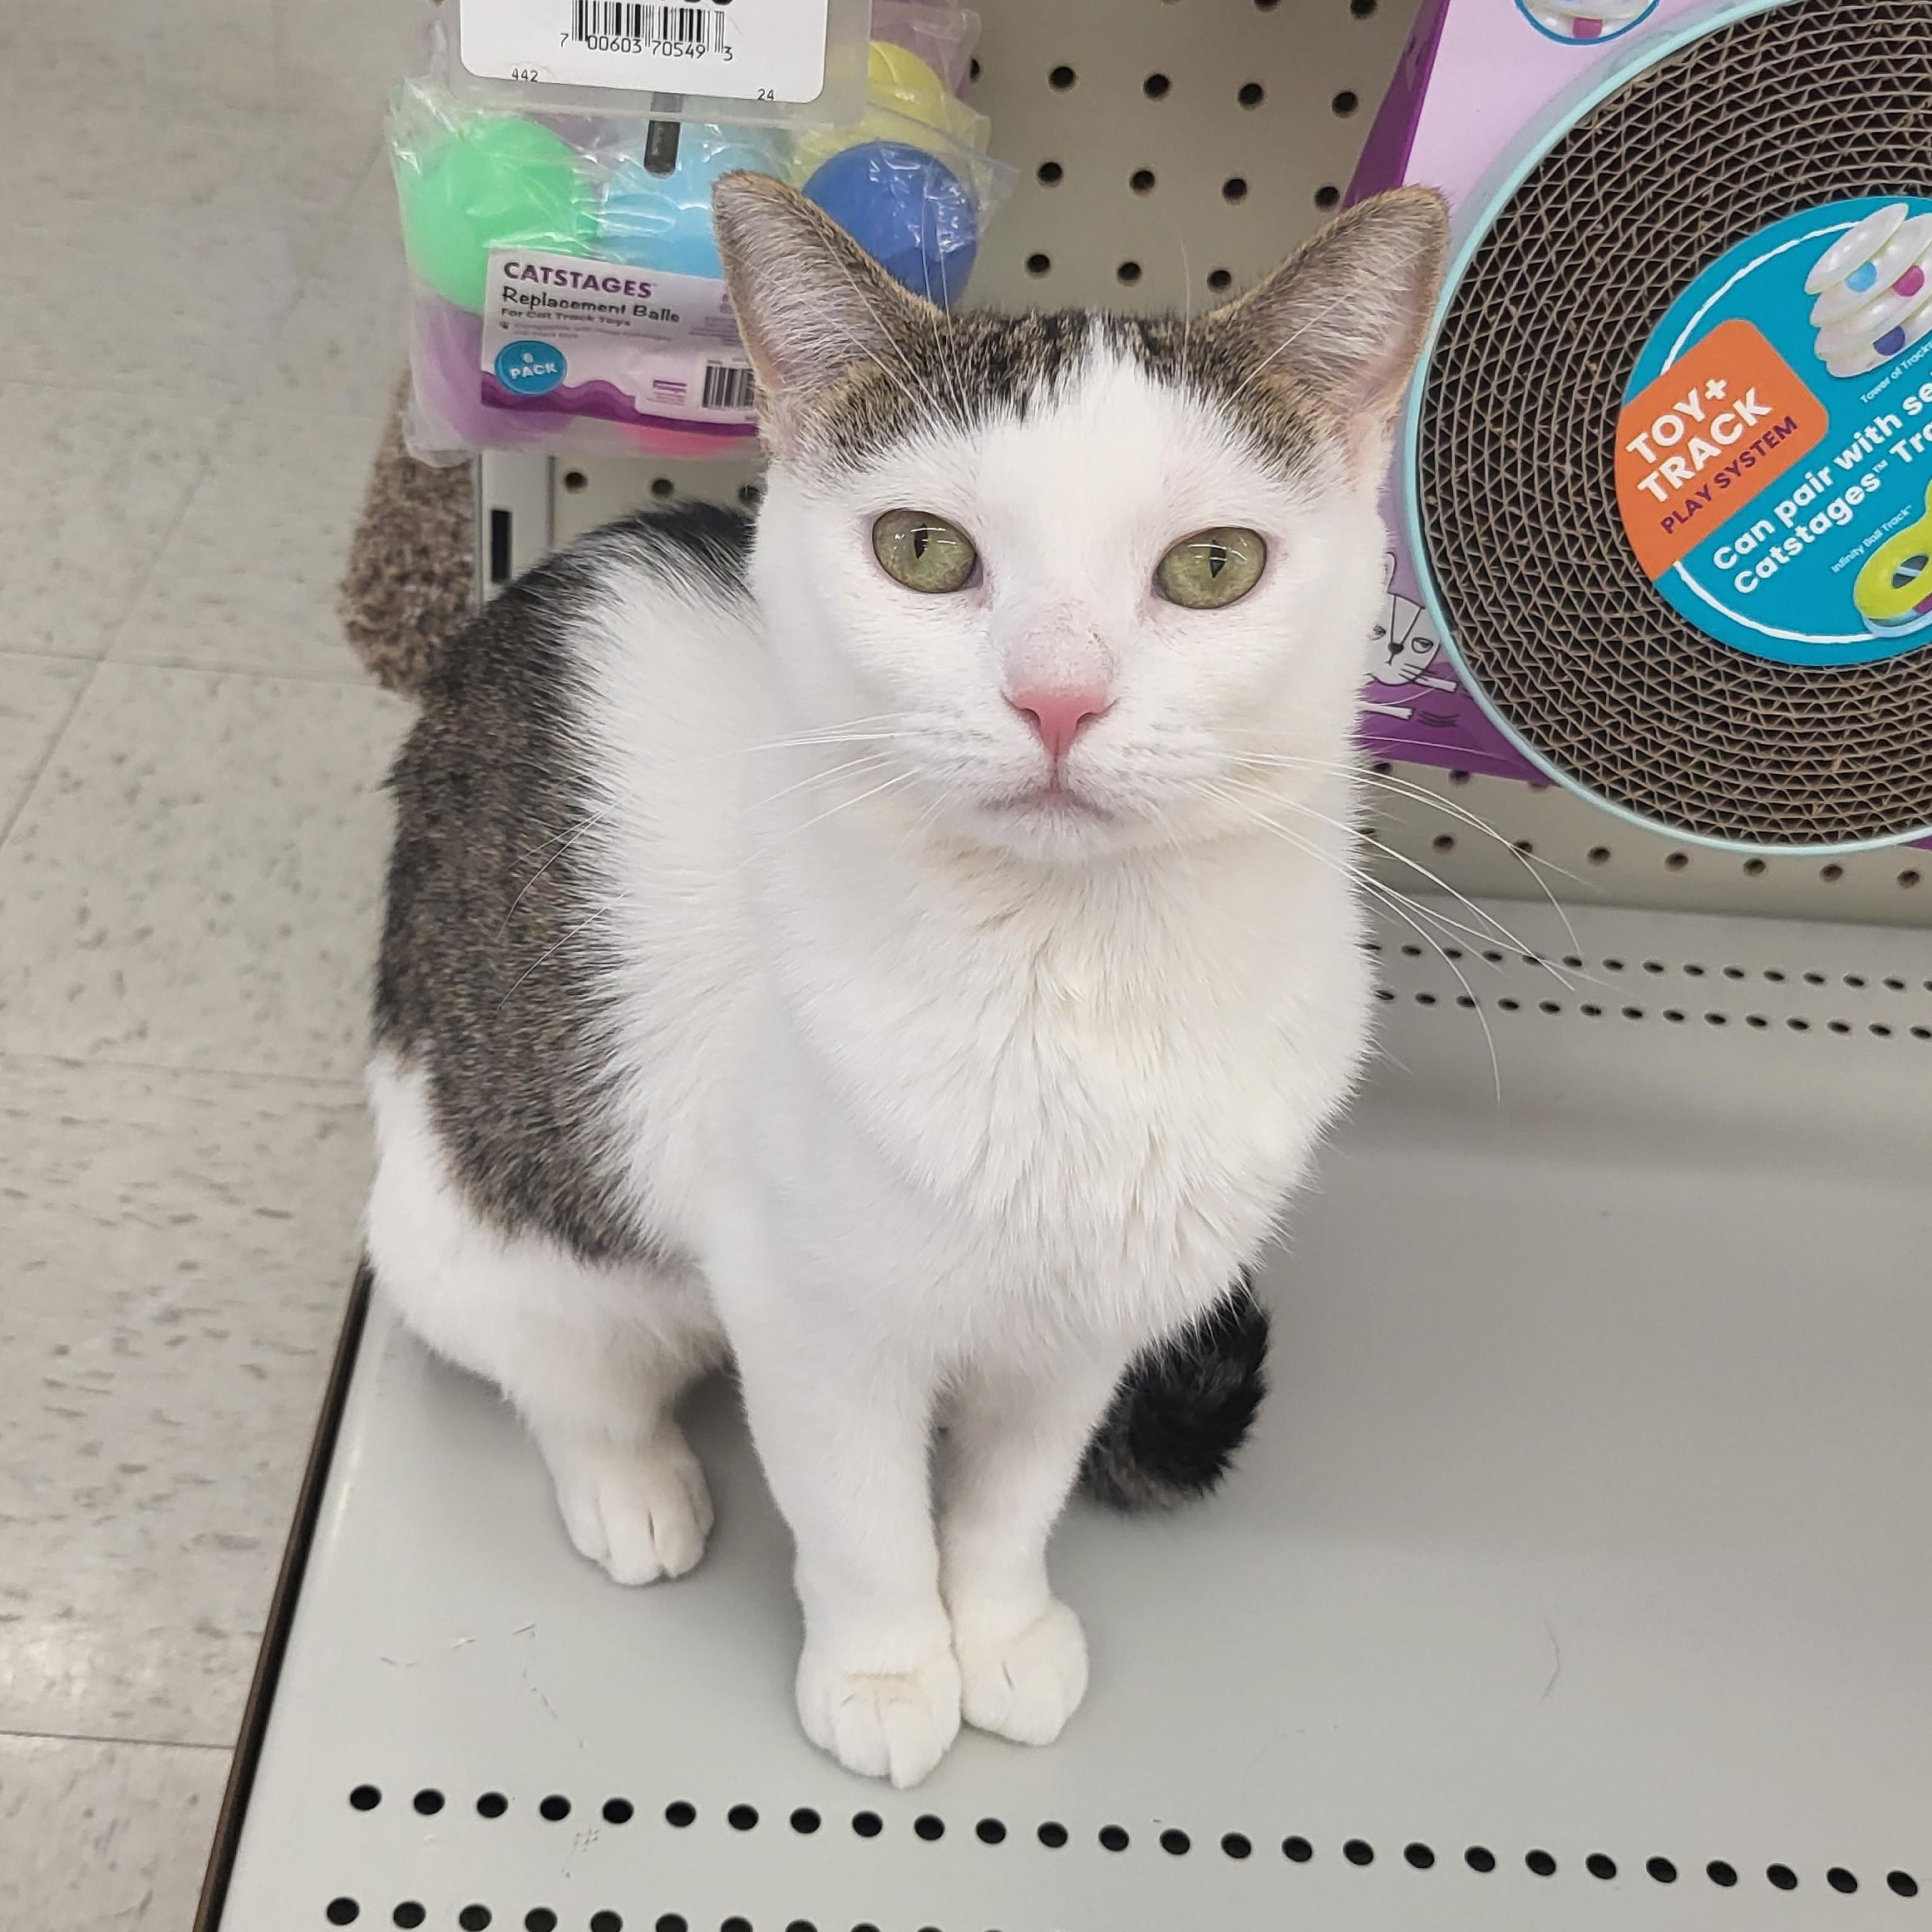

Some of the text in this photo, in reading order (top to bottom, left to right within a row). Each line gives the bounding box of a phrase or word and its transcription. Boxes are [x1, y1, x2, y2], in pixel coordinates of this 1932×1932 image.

[560, 32, 733, 62] 7 00603 70549 3
[511, 67, 539, 83] 442
[757, 88, 775, 101] 24
[501, 285, 626, 315] Replacement
[501, 308, 524, 318] For
[526, 310, 551, 320] Cat
[509, 362, 558, 379] PACK
[1860, 377, 1891, 404] Tower
[1890, 366, 1903, 380] of
[1637, 387, 1773, 502] TRACK
[1660, 416, 1798, 535] PLAY SYSTEM
[1713, 371, 1932, 570] Can pair with se
[1831, 545, 1865, 574] Infinity
[1862, 528, 1884, 548] Ball
